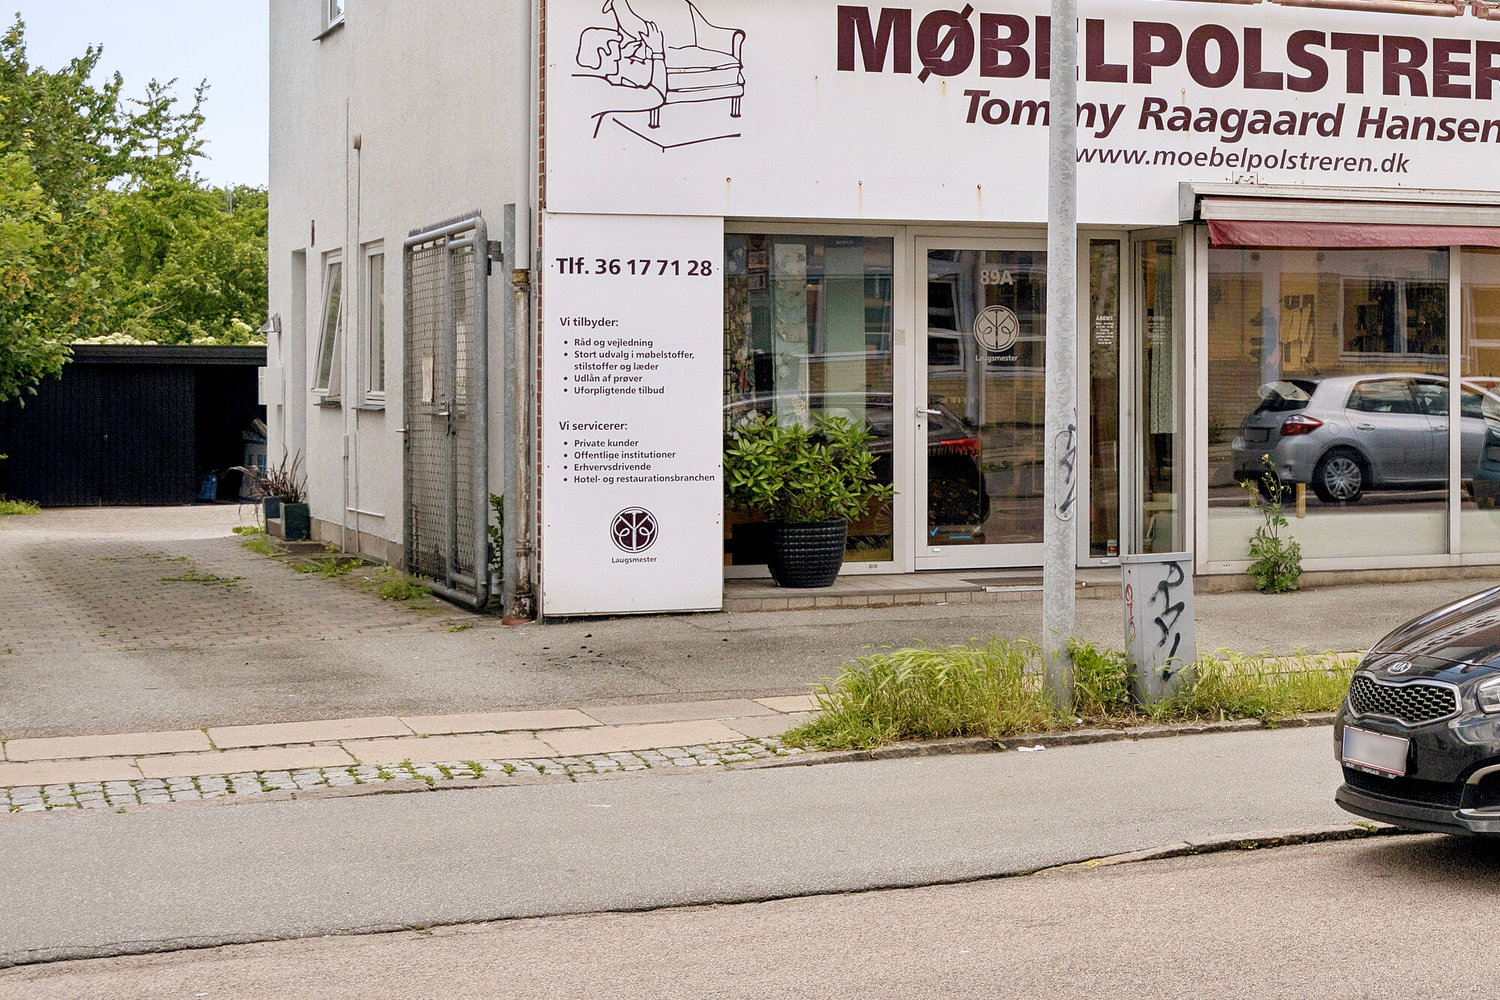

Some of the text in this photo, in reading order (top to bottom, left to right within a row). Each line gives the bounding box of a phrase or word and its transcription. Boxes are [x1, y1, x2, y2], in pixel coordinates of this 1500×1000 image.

[1138, 96, 1345, 141] Raagaard
[1077, 147, 1409, 174] www.moebelpolstreren.dk
[556, 257, 712, 276] Tlf. 36 17 71 28
[980, 270, 1014, 285] 89A
[560, 317, 618, 329] Vi tilbyder:
[575, 338, 653, 348] Råd og vejledning
[599, 351, 629, 360] udvalg
[636, 351, 694, 359] møbelstoffer,
[575, 362, 618, 370] stilstoffer
[575, 374, 642, 384] Udlån af prøver
[574, 386, 664, 396] Uforpligtende tilbud
[559, 421, 627, 430] Vi servicerer:
[575, 439, 605, 447] Private
[574, 451, 619, 460] Offentlige
[574, 463, 651, 471] Erhvervsdrivende
[574, 475, 600, 483] Hotel-
[617, 474, 714, 482] restaurationsbranchen
